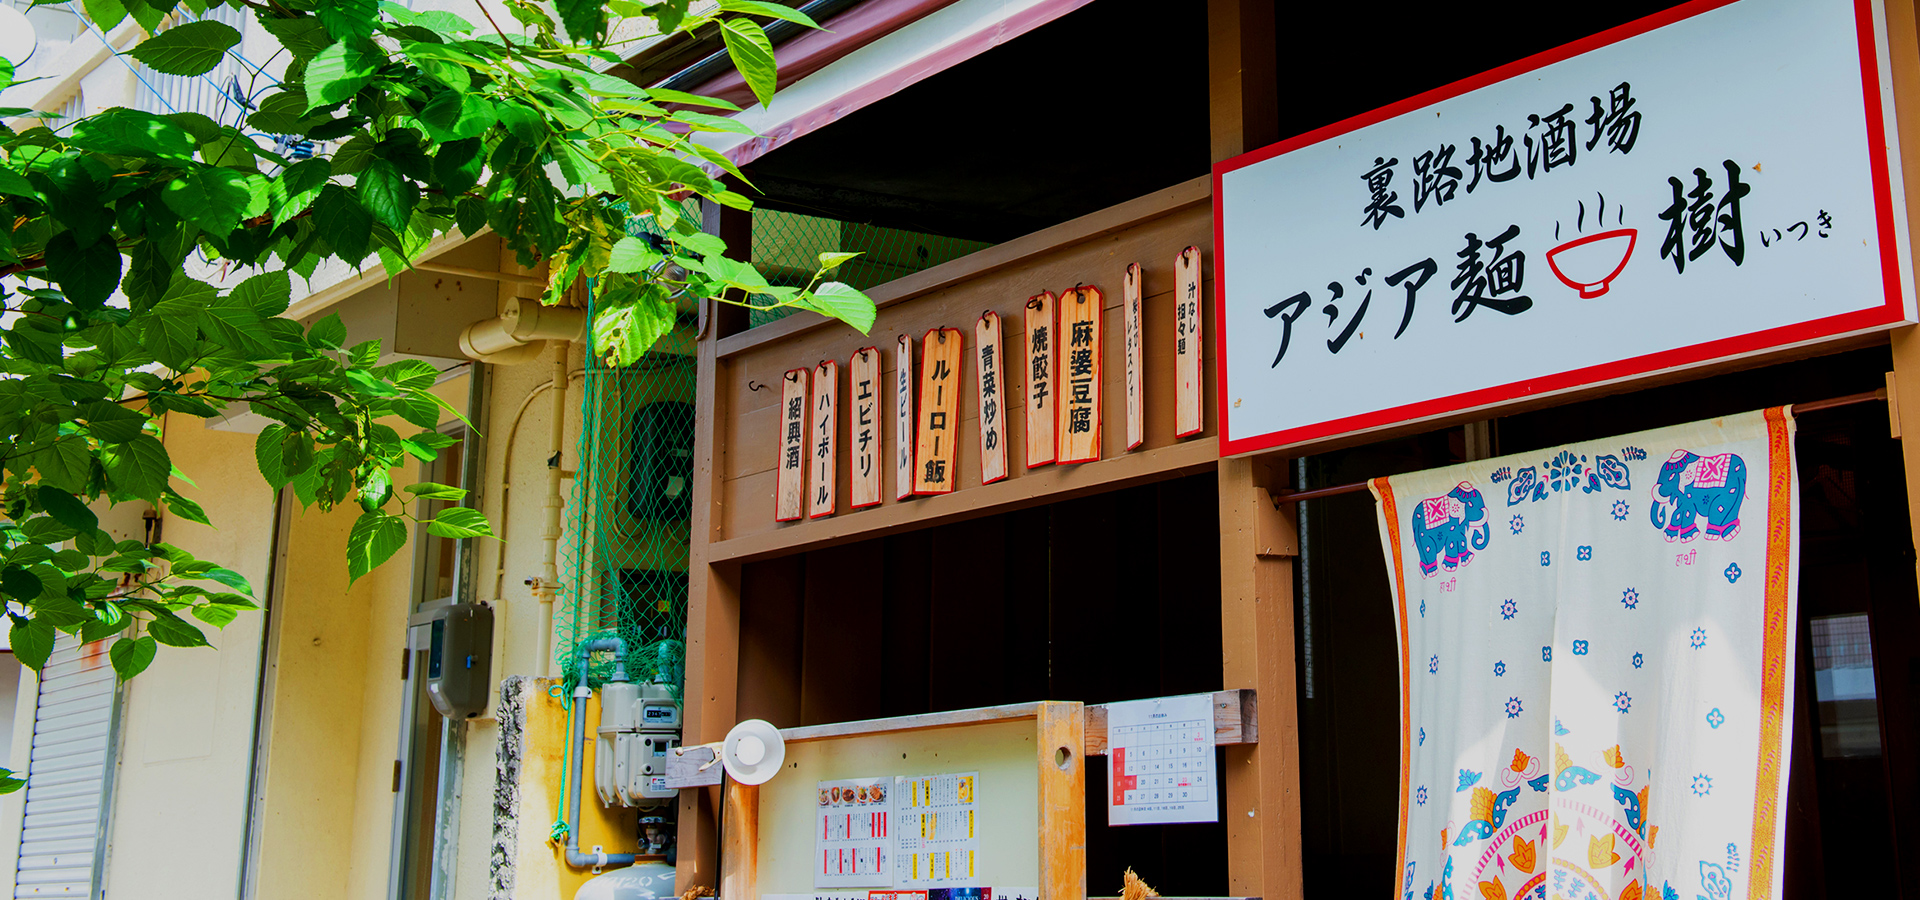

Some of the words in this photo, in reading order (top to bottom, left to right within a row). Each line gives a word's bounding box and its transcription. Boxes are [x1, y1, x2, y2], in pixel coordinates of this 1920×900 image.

[1360, 81, 1643, 231] 裏路地酒場
[1187, 281, 1196, 333] 汁なし
[1263, 224, 1533, 369] アジア麺
[1658, 159, 1751, 275] 樹
[1760, 209, 1834, 249] いつき
[1031, 326, 1048, 409] 焼餃子
[1068, 320, 1093, 434] 麻婆豆腐
[1177, 302, 1186, 355] 担々麺
[786, 396, 802, 470] 紹興酒
[816, 393, 830, 505] ハイボール
[858, 380, 873, 477] エビチリ
[899, 368, 907, 470] 生ビール
[924, 360, 950, 483] ルーロー飯
[981, 345, 998, 450] 青菜炒め
